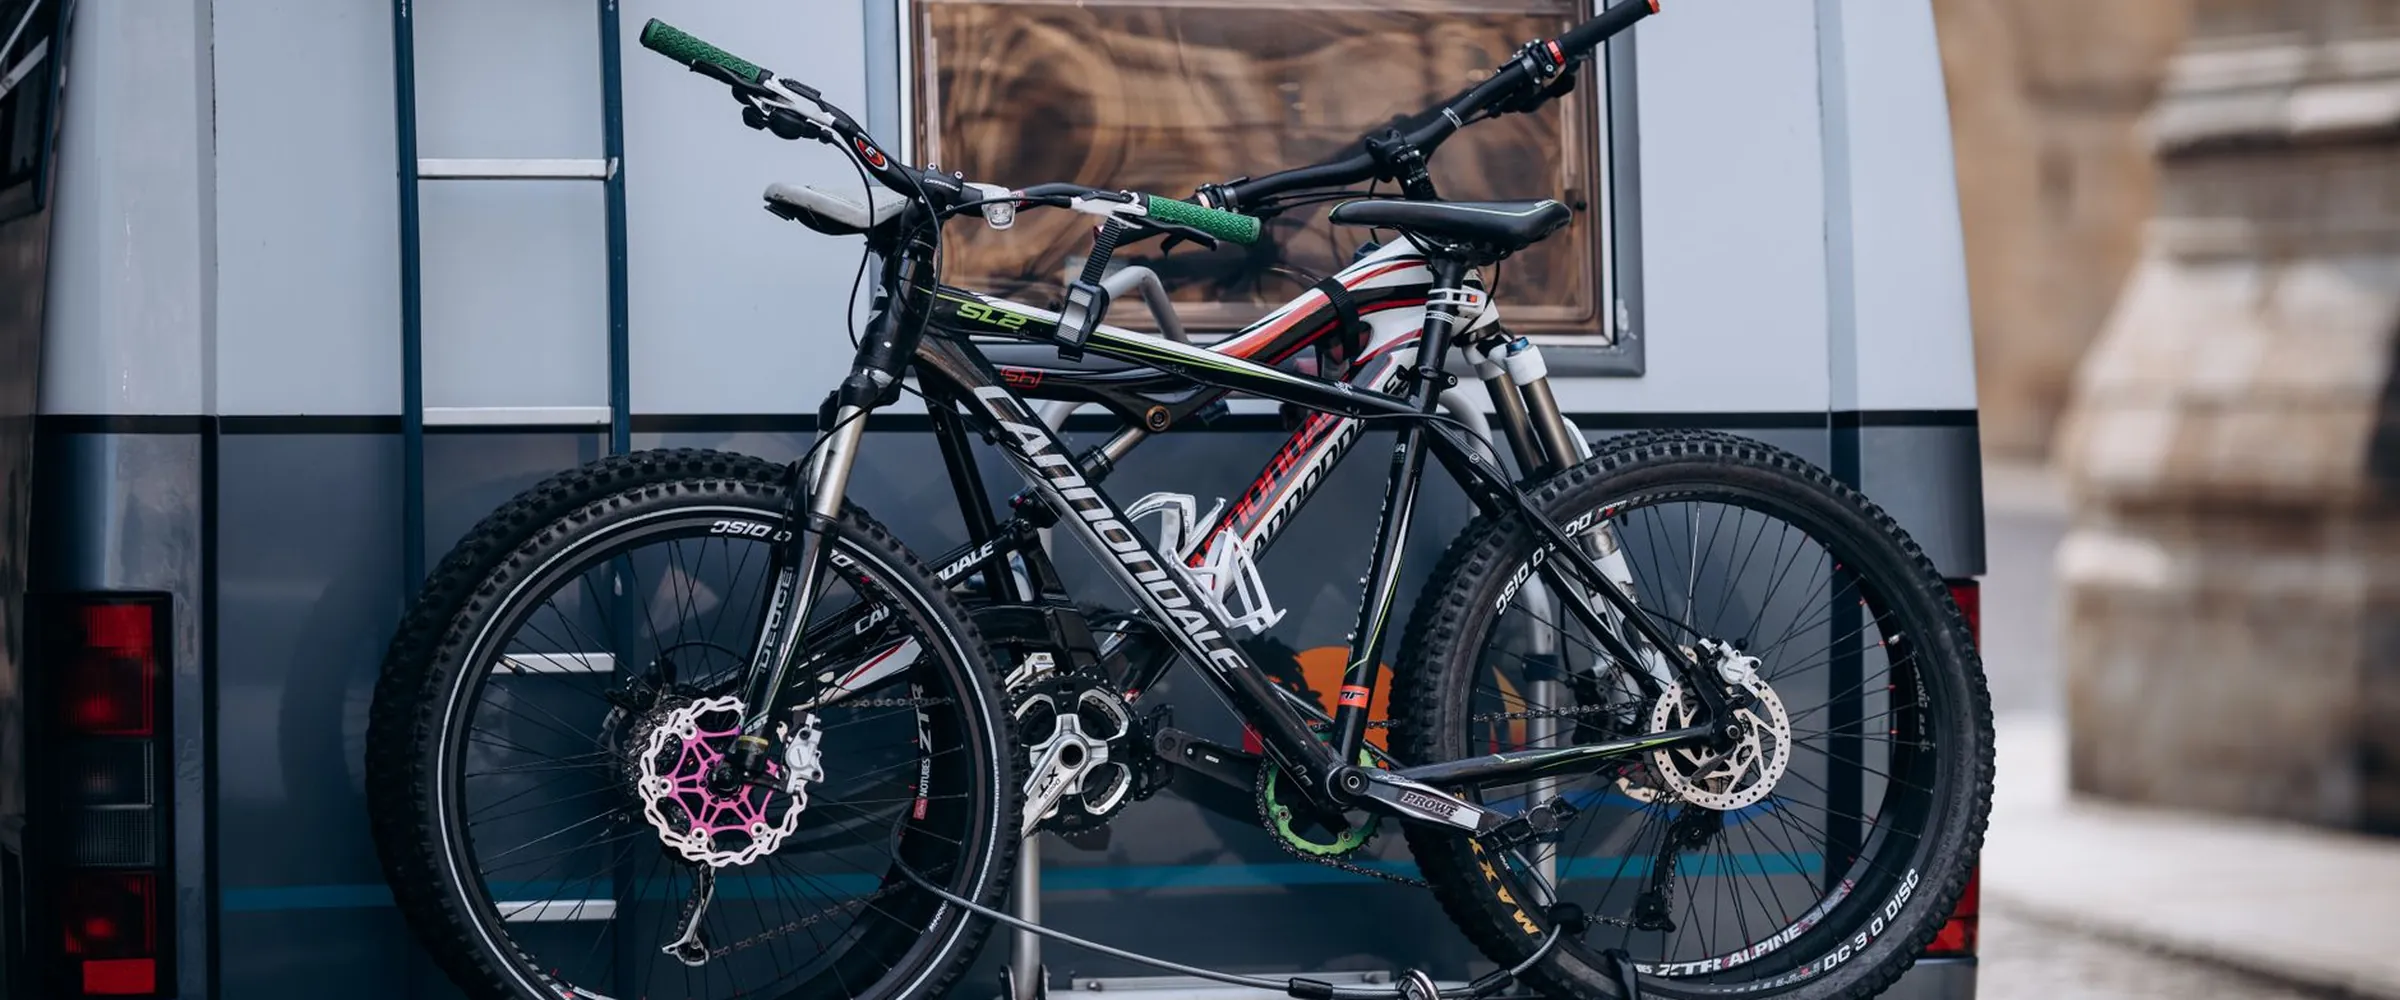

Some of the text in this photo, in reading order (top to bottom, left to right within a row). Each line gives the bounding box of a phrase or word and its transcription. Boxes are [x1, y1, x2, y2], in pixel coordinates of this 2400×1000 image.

[957, 302, 1027, 329] SL2
[710, 520, 772, 538] DISC
[974, 386, 1248, 673] CANNONDALE
[1496, 562, 1529, 615] DISC
[1038, 766, 1059, 798] XT
[1823, 944, 1851, 971] DC
[1885, 868, 1919, 921] DISC
[1656, 922, 1802, 977] ZTR ALPINE
